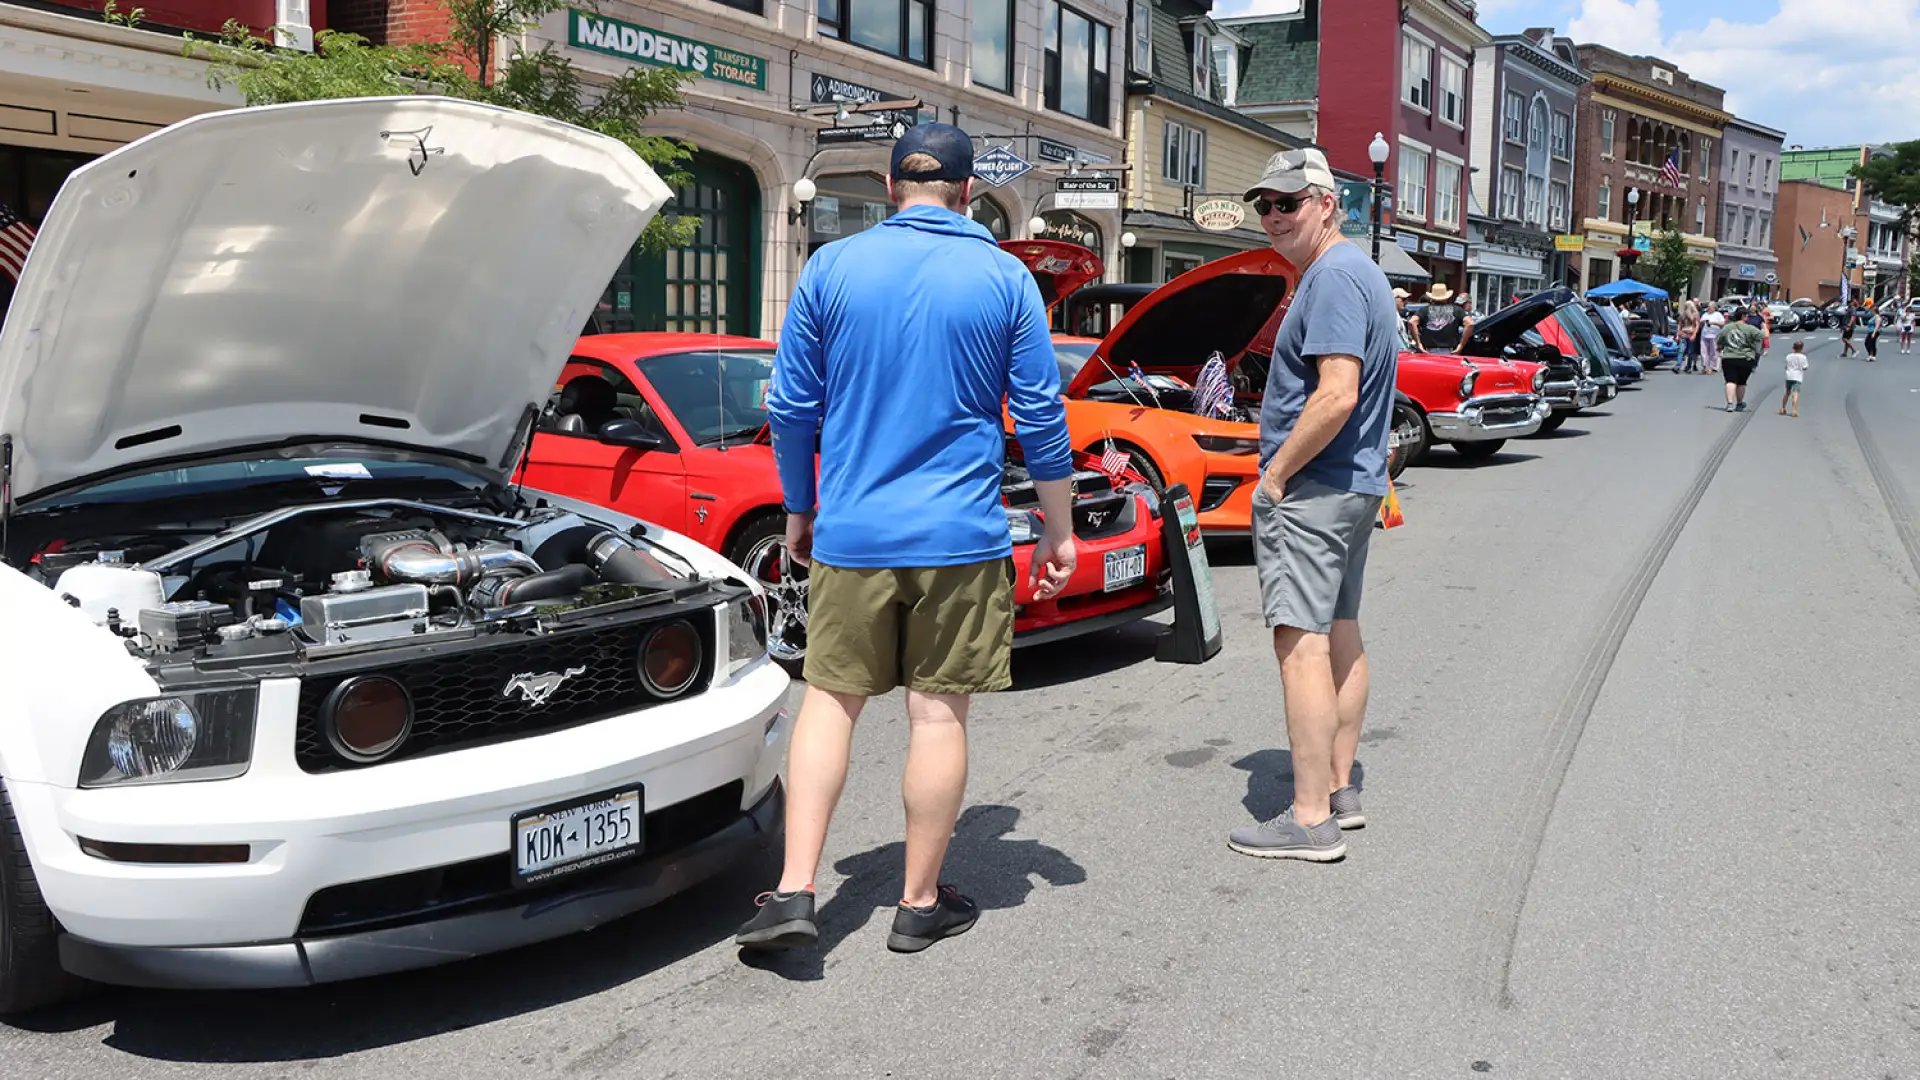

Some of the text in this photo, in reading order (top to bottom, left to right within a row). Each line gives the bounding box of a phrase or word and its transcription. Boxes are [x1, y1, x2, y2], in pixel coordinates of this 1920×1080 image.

[577, 14, 708, 72] MADDEN'S
[714, 49, 758, 70] TRANSFER &
[712, 62, 757, 85] STORAGE
[828, 79, 881, 102] ADIRONDACK
[974, 160, 1023, 173] POWER & LIGHT
[1097, 182, 1110, 190] Dog
[548, 799, 612, 822] NEW YORK
[526, 823, 564, 865] KDK
[584, 805, 631, 849] 1355
[527, 848, 636, 883] www.BRENSPEED.com
